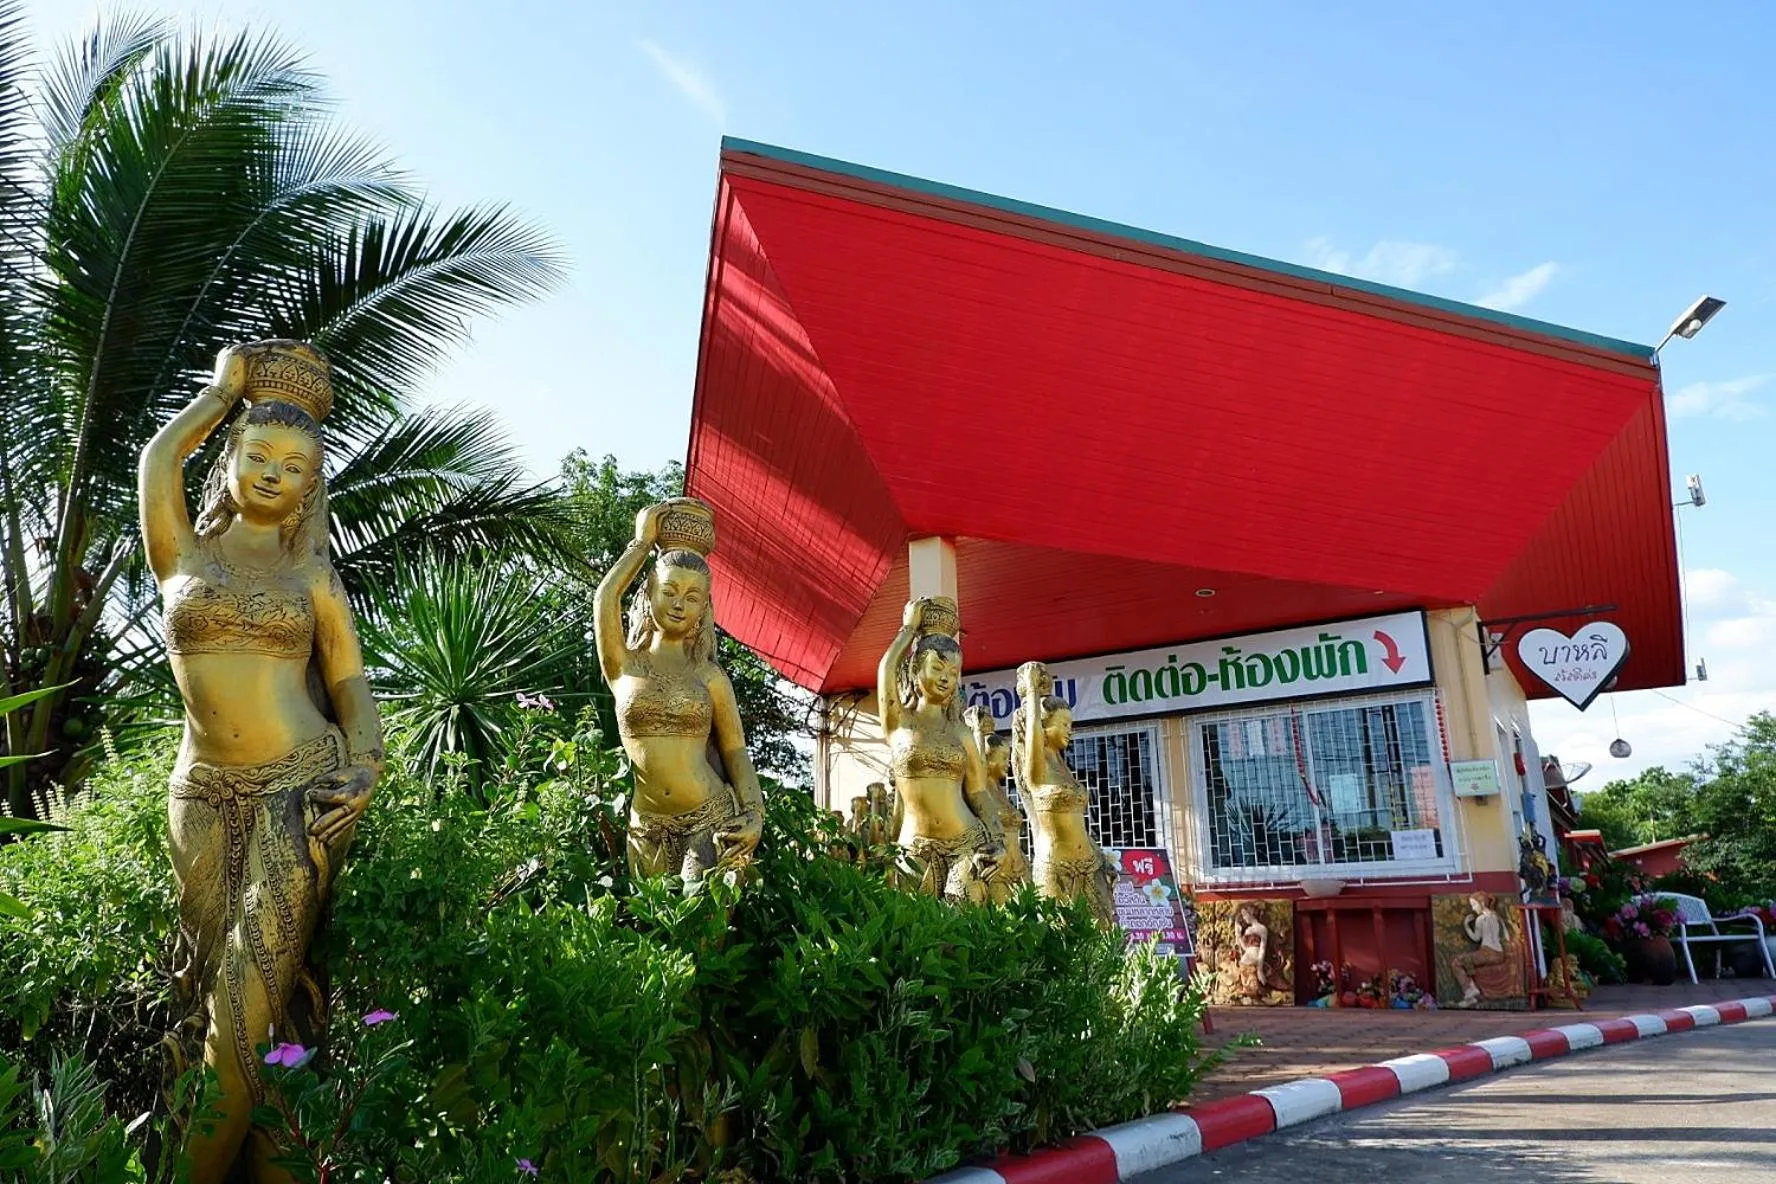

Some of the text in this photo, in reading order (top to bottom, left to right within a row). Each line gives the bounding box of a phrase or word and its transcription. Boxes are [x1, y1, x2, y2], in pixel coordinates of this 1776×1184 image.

[1538, 634, 1608, 665] บาหลี
[1102, 632, 1368, 706] ติดต่อ-ห้องพัก
[1132, 857, 1154, 876] ฟรี
